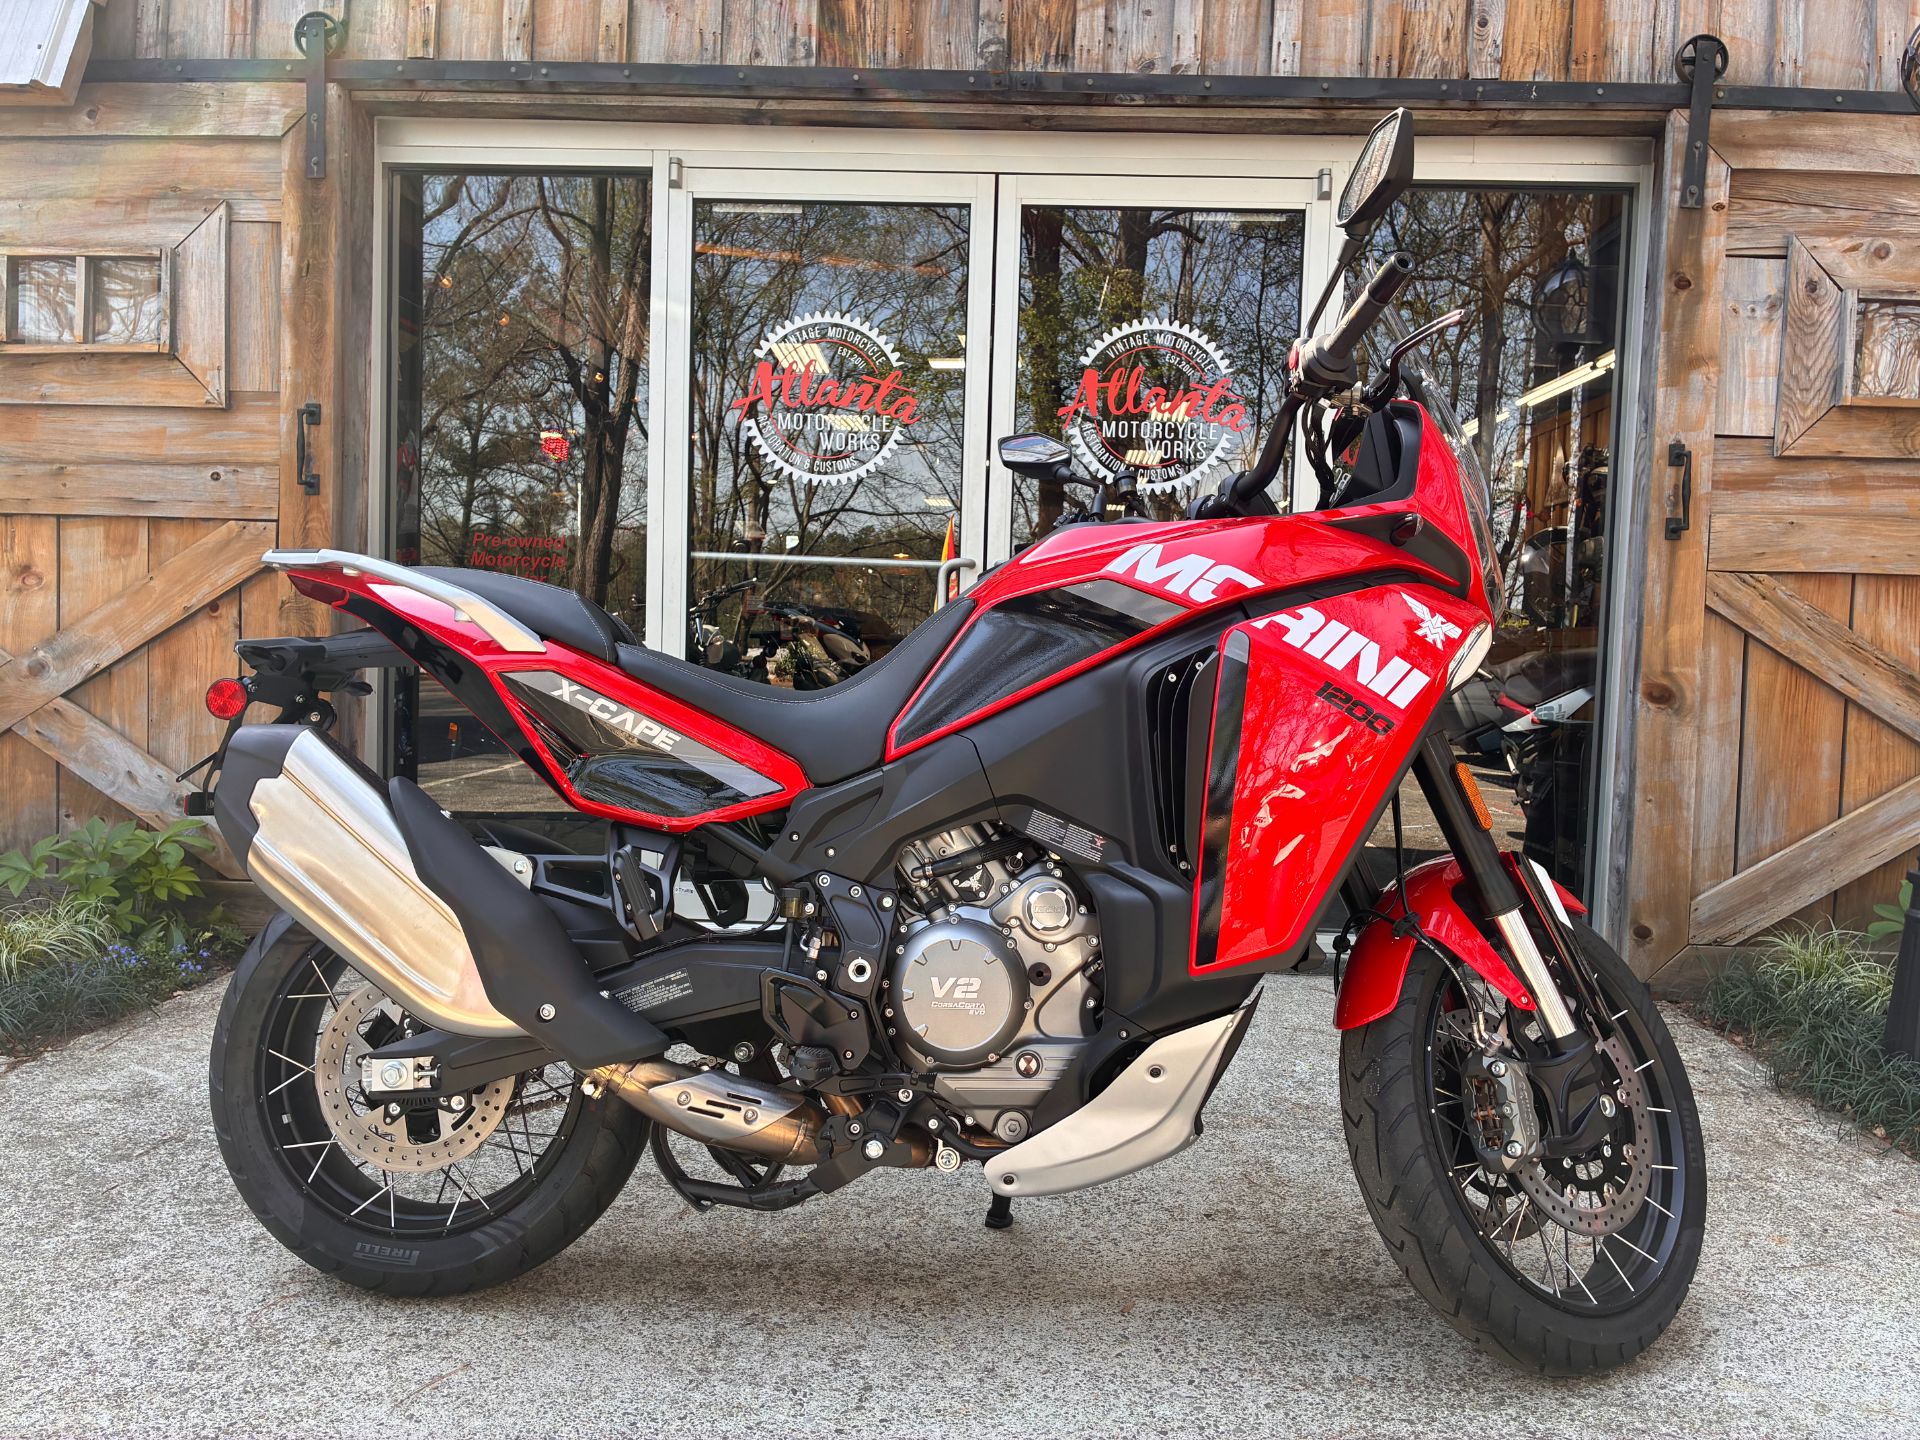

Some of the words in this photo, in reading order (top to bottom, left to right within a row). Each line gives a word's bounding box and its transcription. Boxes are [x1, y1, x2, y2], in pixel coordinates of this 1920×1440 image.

[827, 326, 886, 365] MOTORCYCLE
[1106, 333, 1148, 359] VINTAGE
[1156, 333, 1215, 372] MOTORCYCLE
[731, 359, 924, 425] Atlanta
[1057, 365, 1249, 432] Atlanta
[777, 413, 891, 432] MOTOCLE
[1102, 420, 1218, 440] MOTORCYCLE
[757, 415, 801, 465] RESTORATION
[813, 456, 857, 472] CUSTOMS
[820, 432, 880, 452] WORKS
[1082, 423, 1127, 472] RESTORATION
[1137, 464, 1181, 480] CUSTOMS
[1145, 439, 1207, 459] WORKS
[472, 532, 566, 549] Pre-owned
[470, 551, 567, 570] Motorcycle
[550, 679, 682, 751] X-CAPE
[1315, 681, 1395, 736] 1200
[930, 976, 982, 998] V2
[352, 1242, 421, 1266] PIRELLI
